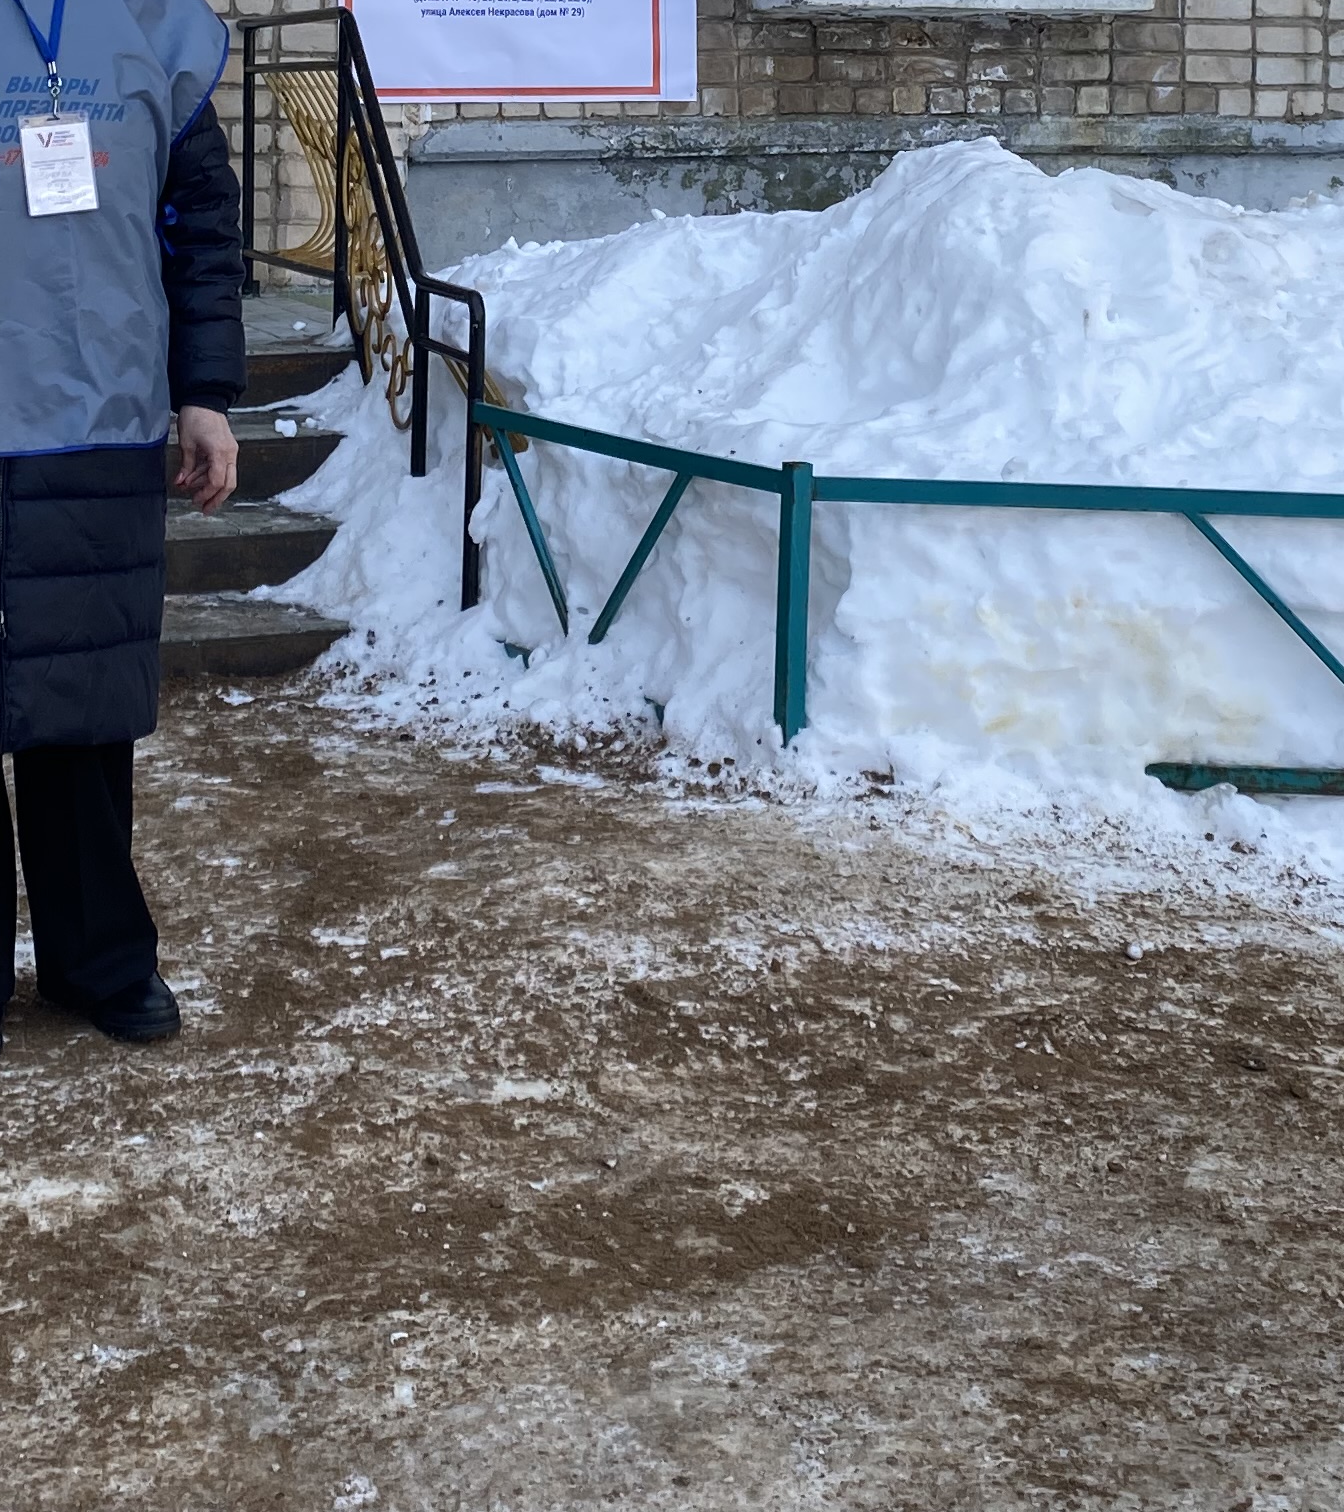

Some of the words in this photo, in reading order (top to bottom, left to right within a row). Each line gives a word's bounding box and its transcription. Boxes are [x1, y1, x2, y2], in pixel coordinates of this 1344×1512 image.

[420, 8, 447, 18] улица
[449, 7, 486, 17] Алексея
[488, 7, 535, 18] Некрасова
[536, 7, 557, 18] (дом
[571, 7, 584, 18] 29)
